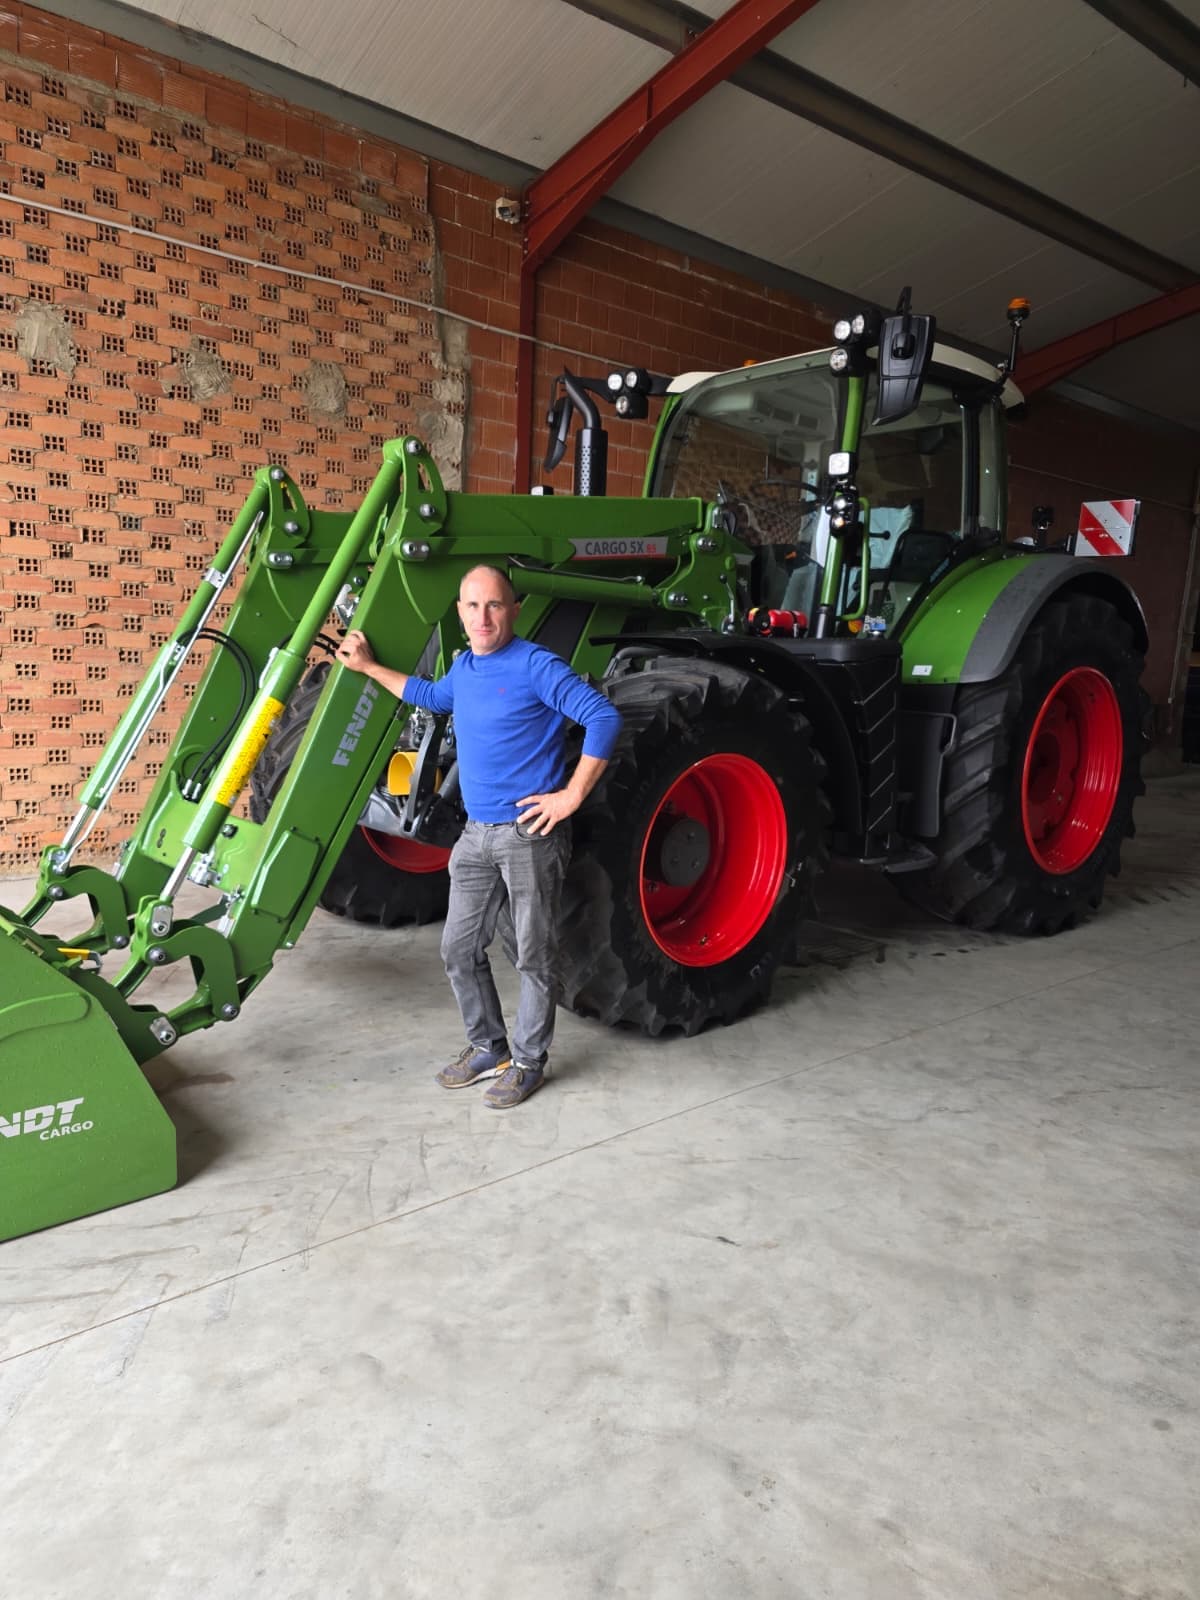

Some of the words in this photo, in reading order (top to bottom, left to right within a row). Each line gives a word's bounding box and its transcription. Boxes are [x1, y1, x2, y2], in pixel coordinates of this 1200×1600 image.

[585, 541, 627, 555] CARGO
[630, 541, 644, 554] 5X
[331, 678, 379, 767] FENDT
[39, 1120, 94, 1141] CARGO
